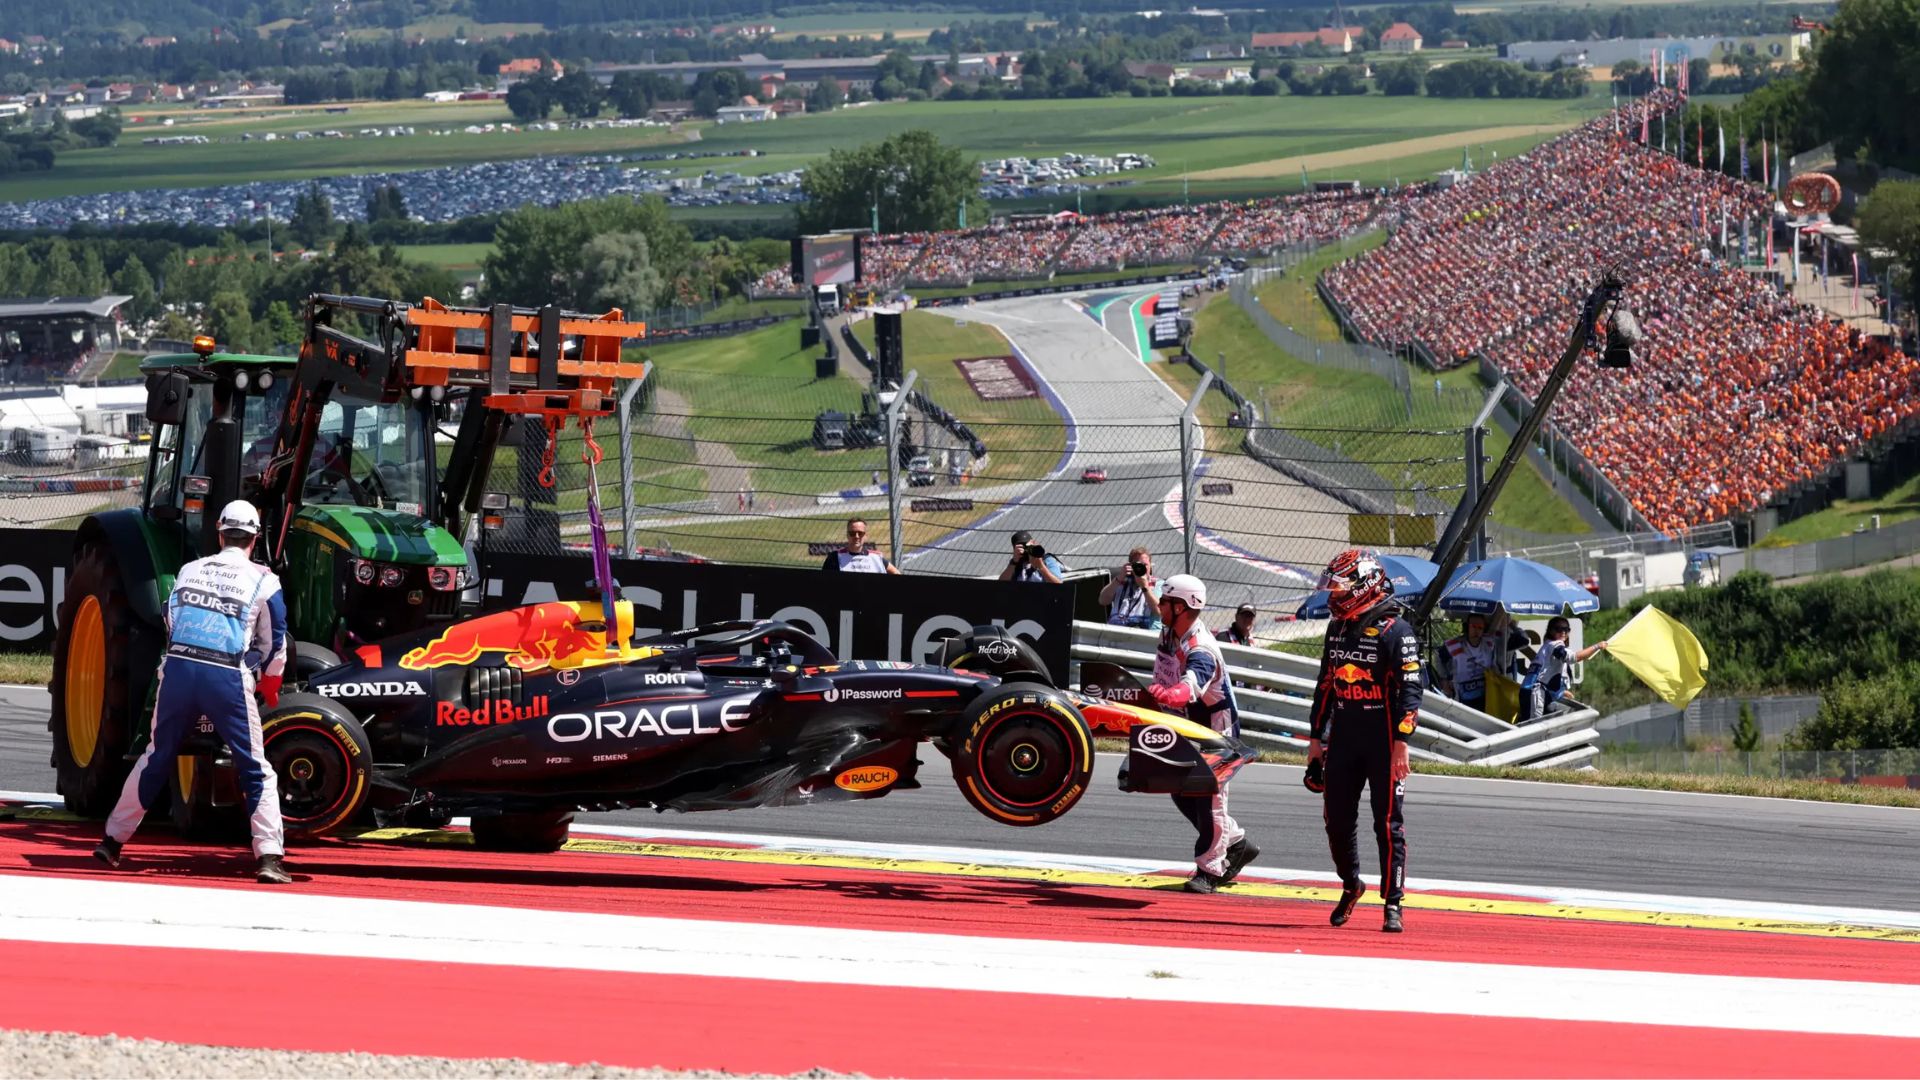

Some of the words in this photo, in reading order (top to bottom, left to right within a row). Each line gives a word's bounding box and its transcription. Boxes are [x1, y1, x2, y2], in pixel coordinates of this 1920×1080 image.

[220, 582, 245, 596] CREW
[1352, 585, 1370, 598] Red
[355, 645, 382, 668] 1
[978, 645, 998, 655] Hard
[1329, 650, 1378, 663] ORACLE
[644, 672, 688, 685] ROKT
[316, 681, 427, 698] HONDA
[841, 688, 902, 700] 1Password
[1105, 688, 1142, 701] AT&T
[1353, 685, 1382, 700] Bull
[437, 699, 489, 727] Red
[495, 695, 549, 724] Bull
[970, 697, 1016, 737] ZERO
[547, 699, 752, 742] ORACLE
[1144, 732, 1171, 744] Esso
[592, 753, 628, 762] SIEMENS
[851, 772, 890, 785] RAUCH
